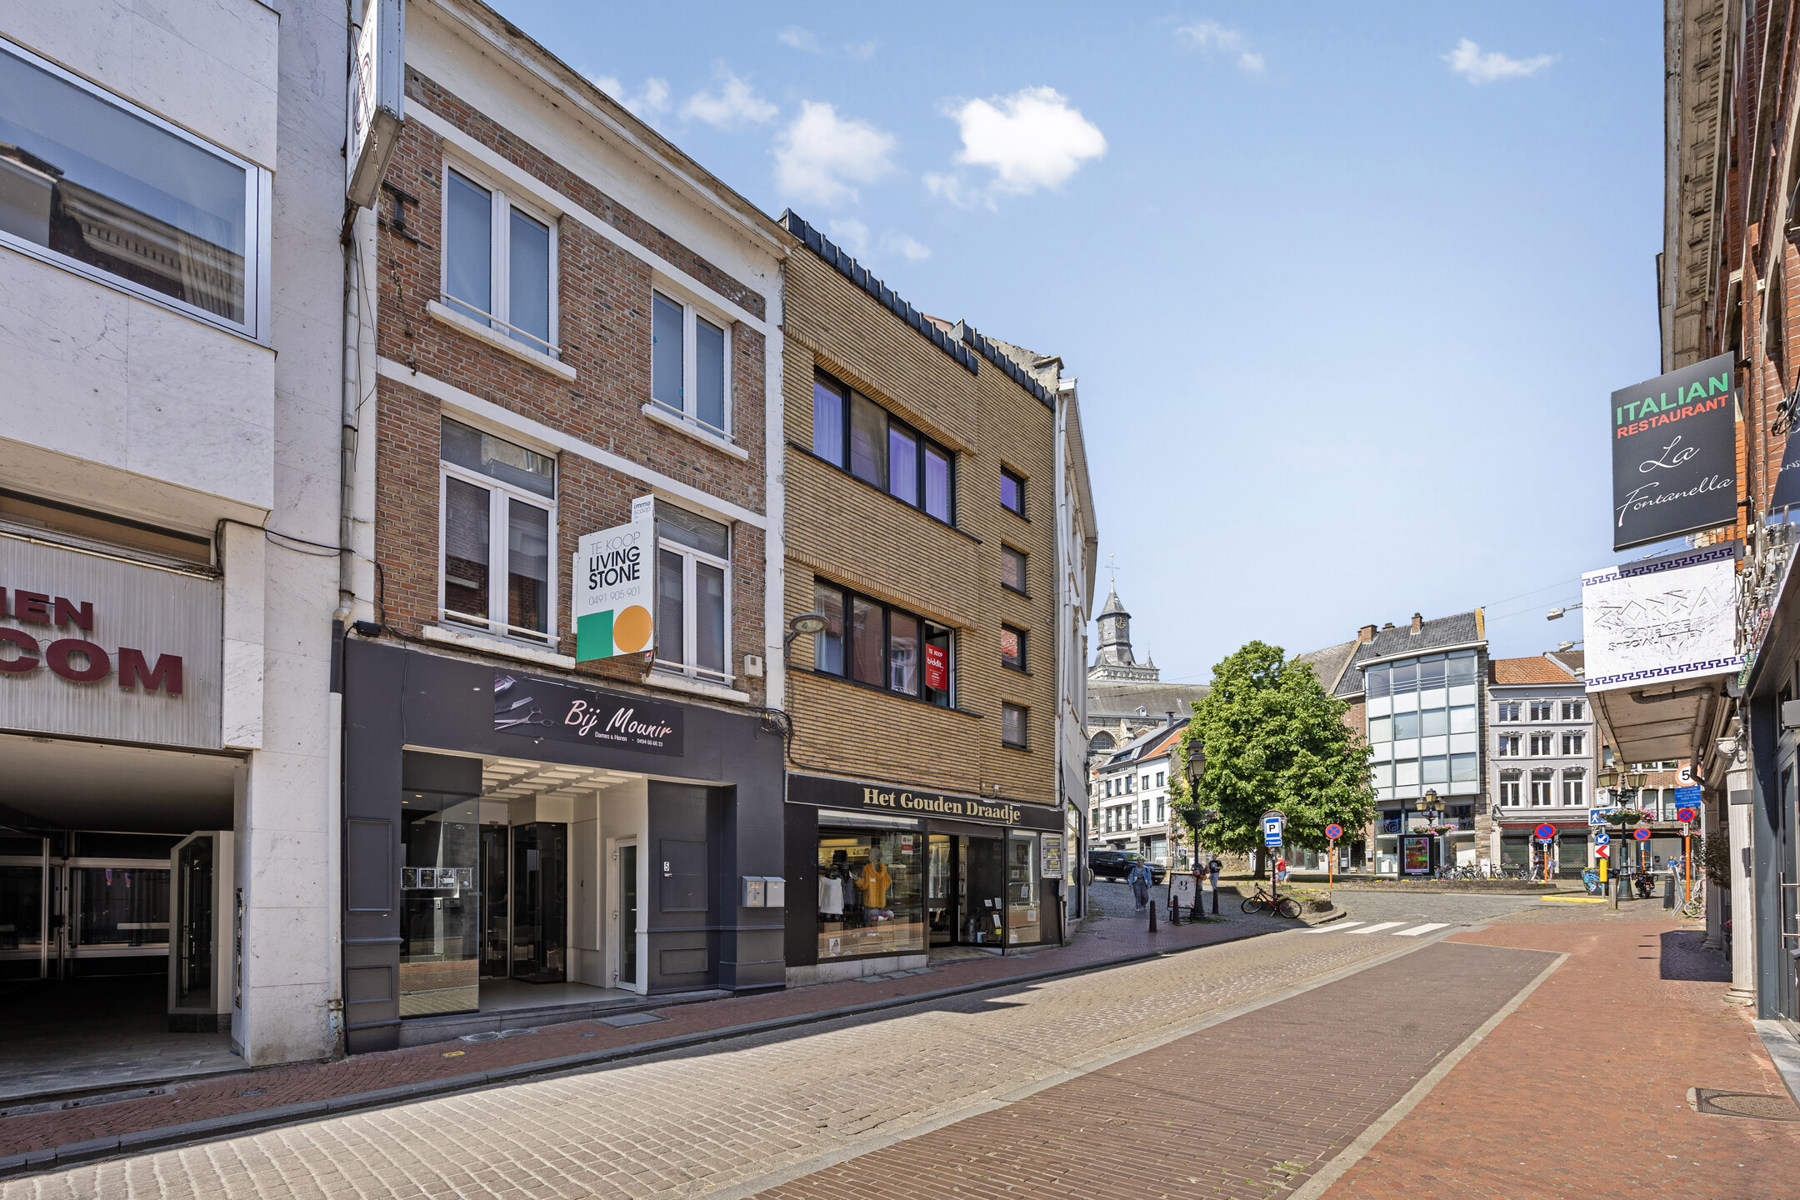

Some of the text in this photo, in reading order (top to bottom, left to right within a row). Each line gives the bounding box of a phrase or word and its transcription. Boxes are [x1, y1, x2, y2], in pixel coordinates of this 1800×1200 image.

[1616, 372, 1729, 426] ITALIAN
[1617, 394, 1729, 439] RESTAURANT
[1639, 435, 1700, 473] La
[1616, 474, 1734, 527] Fontanella
[589, 546, 641, 573] LIVING
[590, 532, 641, 555] TE KOOP
[588, 562, 640, 591] STONE
[588, 593, 607, 606] 0491
[626, 586, 640, 598] 901
[564, 700, 673, 739] Bij Mounir
[863, 787, 1021, 825] Het Gouden Draadje
[1269, 824, 1276, 832] P
[664, 862, 669, 871] 5
